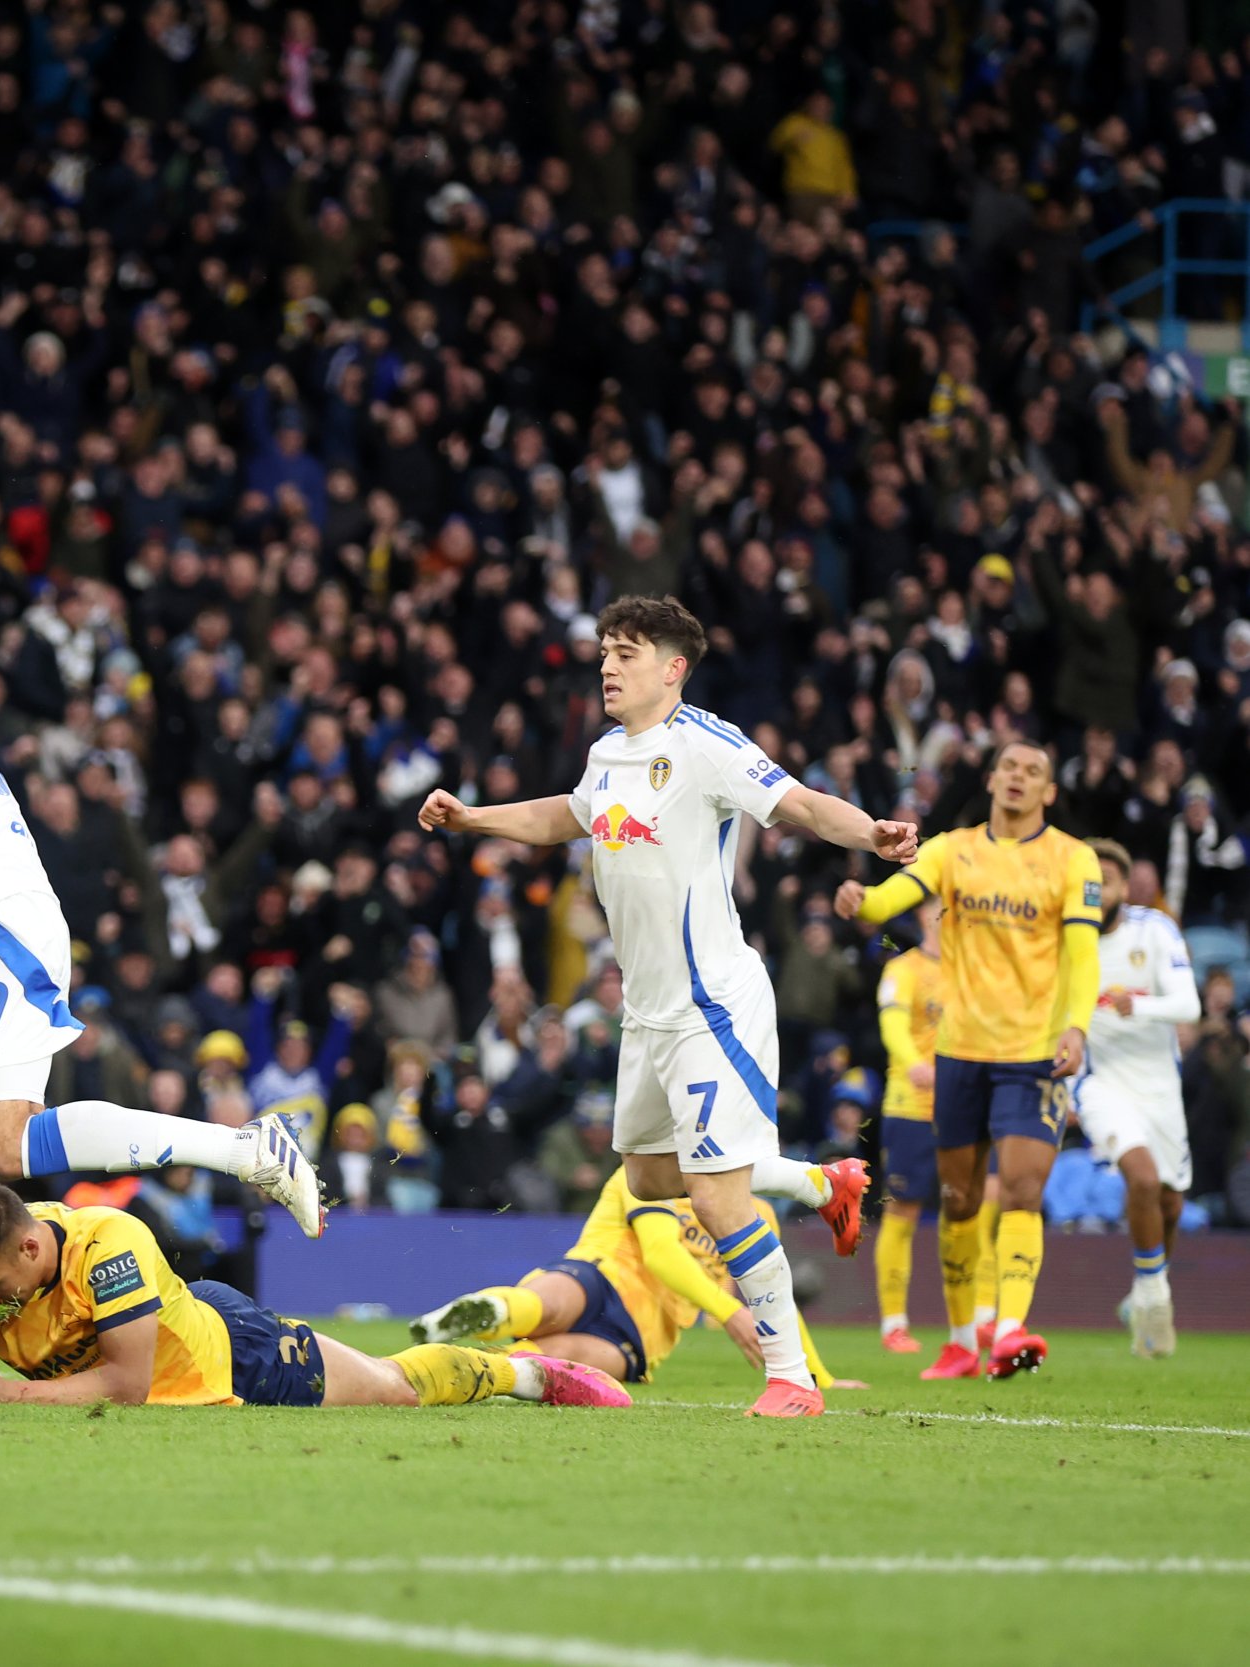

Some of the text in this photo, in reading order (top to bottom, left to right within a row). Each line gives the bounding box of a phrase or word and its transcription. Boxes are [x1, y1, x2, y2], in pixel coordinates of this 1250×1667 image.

[687, 1080, 718, 1133] 7
[1036, 1079, 1068, 1121] 19
[88, 1255, 137, 1284] TONIC
